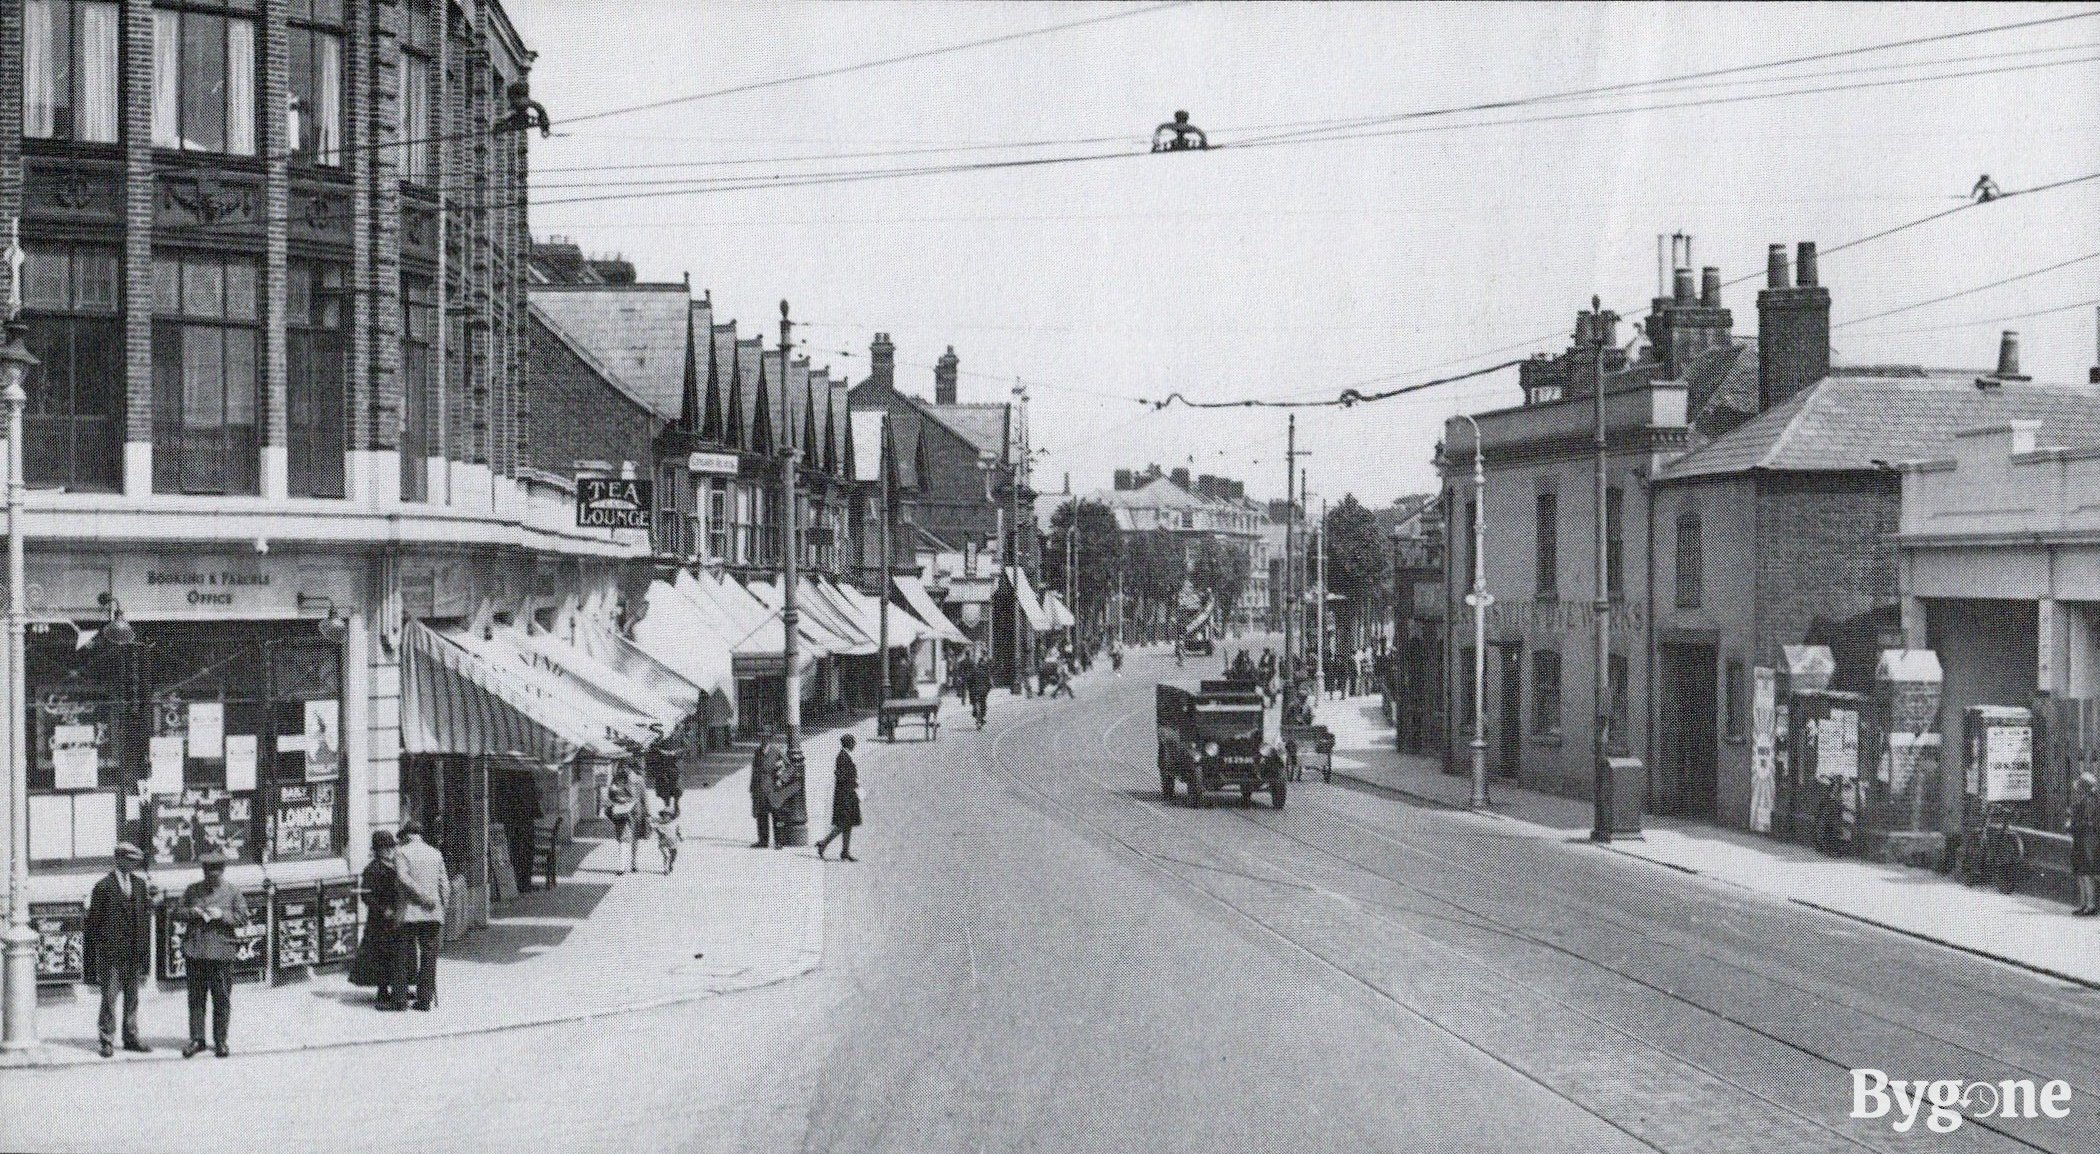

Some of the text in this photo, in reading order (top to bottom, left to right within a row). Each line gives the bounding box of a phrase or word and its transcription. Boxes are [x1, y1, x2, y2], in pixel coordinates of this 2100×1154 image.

[586, 482, 640, 506] TEA
[580, 503, 650, 527] LOUNGE
[1580, 602, 1645, 632] WRKS
[277, 805, 334, 830] LONDON
